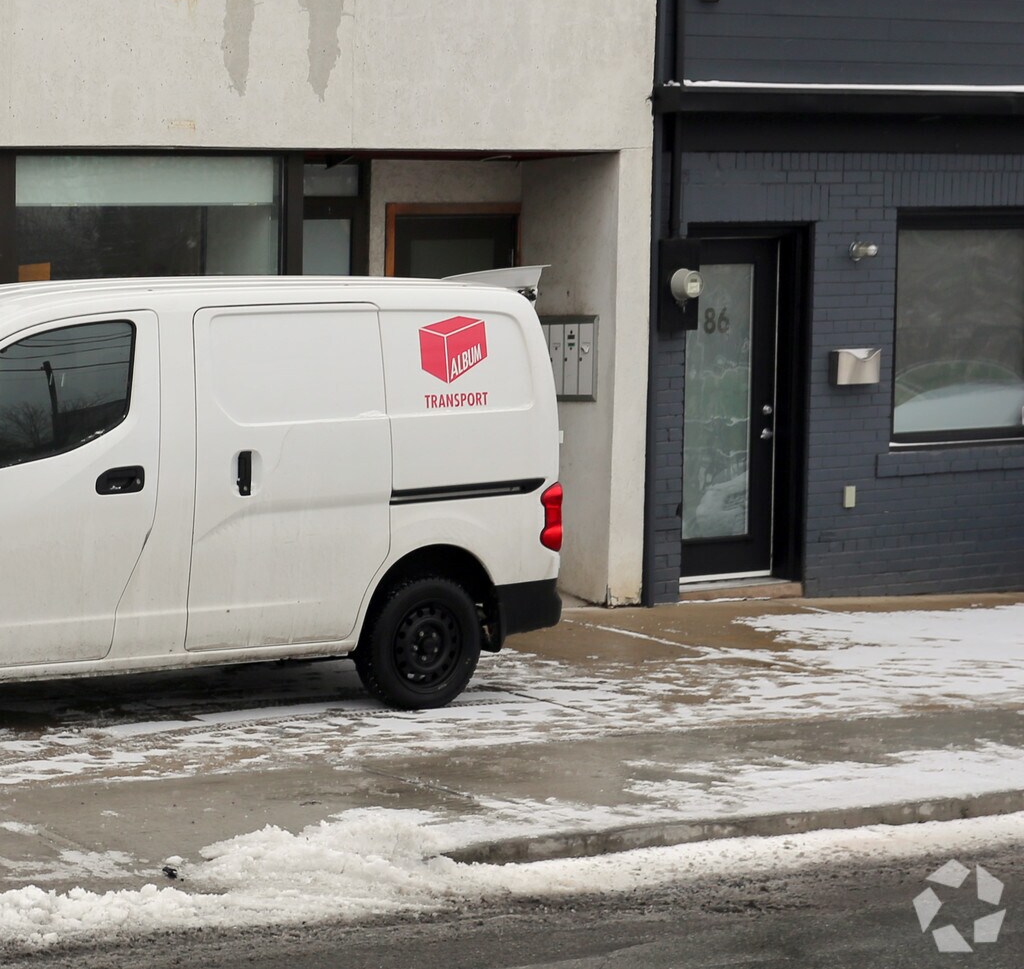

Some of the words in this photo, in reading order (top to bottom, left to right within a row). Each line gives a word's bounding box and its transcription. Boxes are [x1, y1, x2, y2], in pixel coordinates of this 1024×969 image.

[703, 306, 730, 334] 86
[450, 343, 482, 380] ALBUM
[425, 391, 488, 408] TRANSPORT
